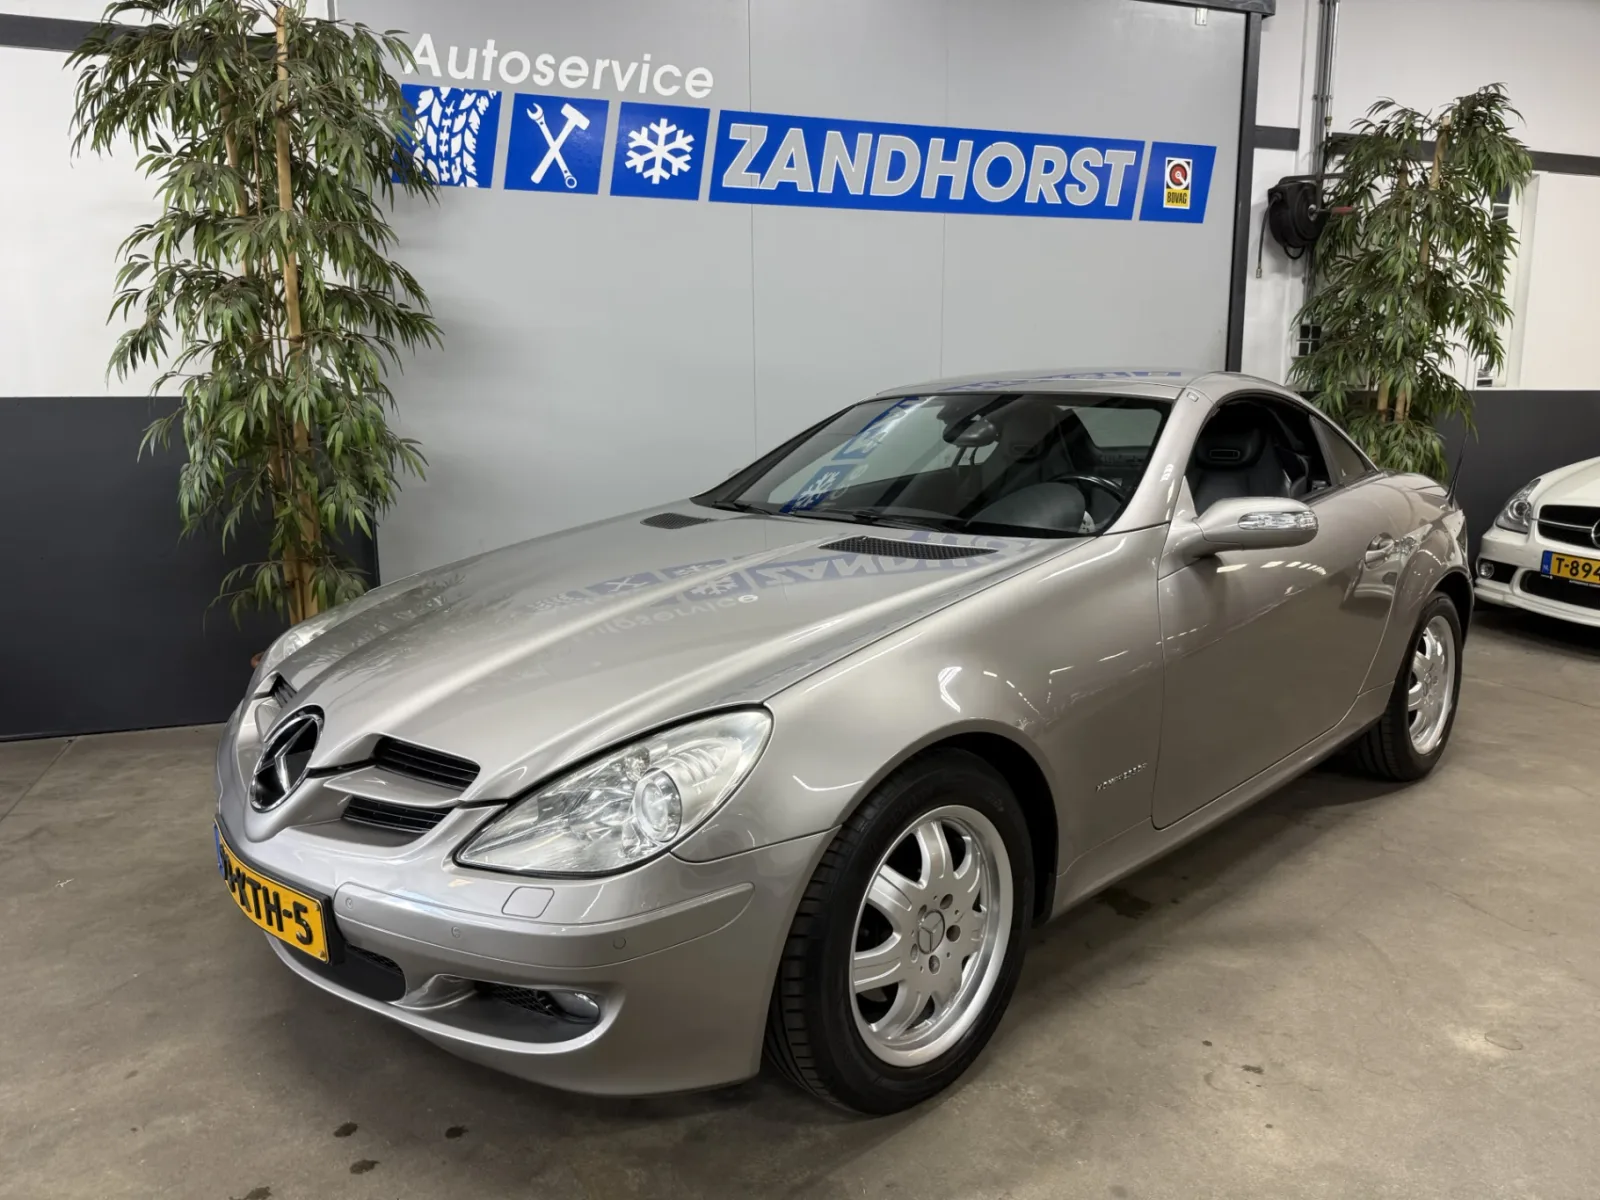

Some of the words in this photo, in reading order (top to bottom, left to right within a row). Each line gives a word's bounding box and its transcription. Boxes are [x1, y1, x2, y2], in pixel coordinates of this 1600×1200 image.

[403, 32, 714, 99] Autoservice
[722, 123, 1137, 207] ZANDHORST
[1167, 191, 1188, 204] BOVAG
